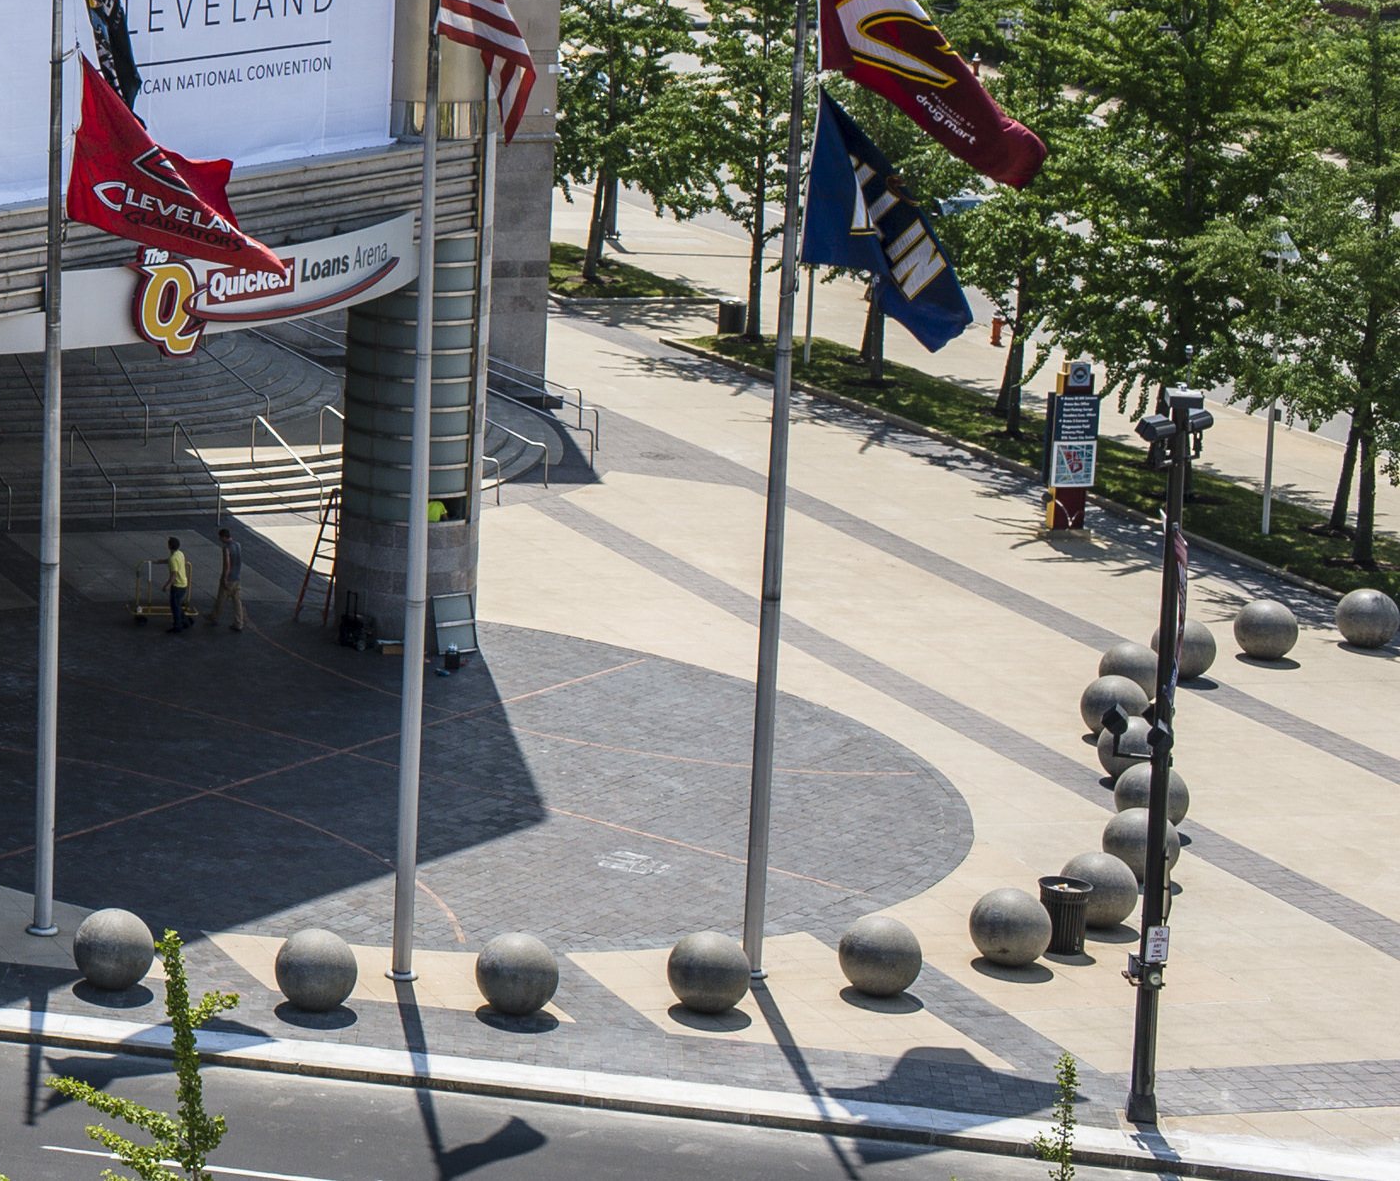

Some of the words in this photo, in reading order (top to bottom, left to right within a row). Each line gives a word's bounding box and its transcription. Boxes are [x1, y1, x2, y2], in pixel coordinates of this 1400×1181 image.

[176, 68, 243, 91] NATIONAL
[246, 56, 333, 81] CONVENTION
[916, 94, 945, 122] drug
[944, 119, 977, 145] mart
[93, 181, 261, 249] CLEVELA
[123, 210, 245, 252] GLADIATORS
[144, 247, 170, 265] The
[300, 252, 350, 283] Loans
[353, 241, 388, 271] Arena
[139, 262, 204, 355] Q
[1154, 929, 1164, 937] NO
